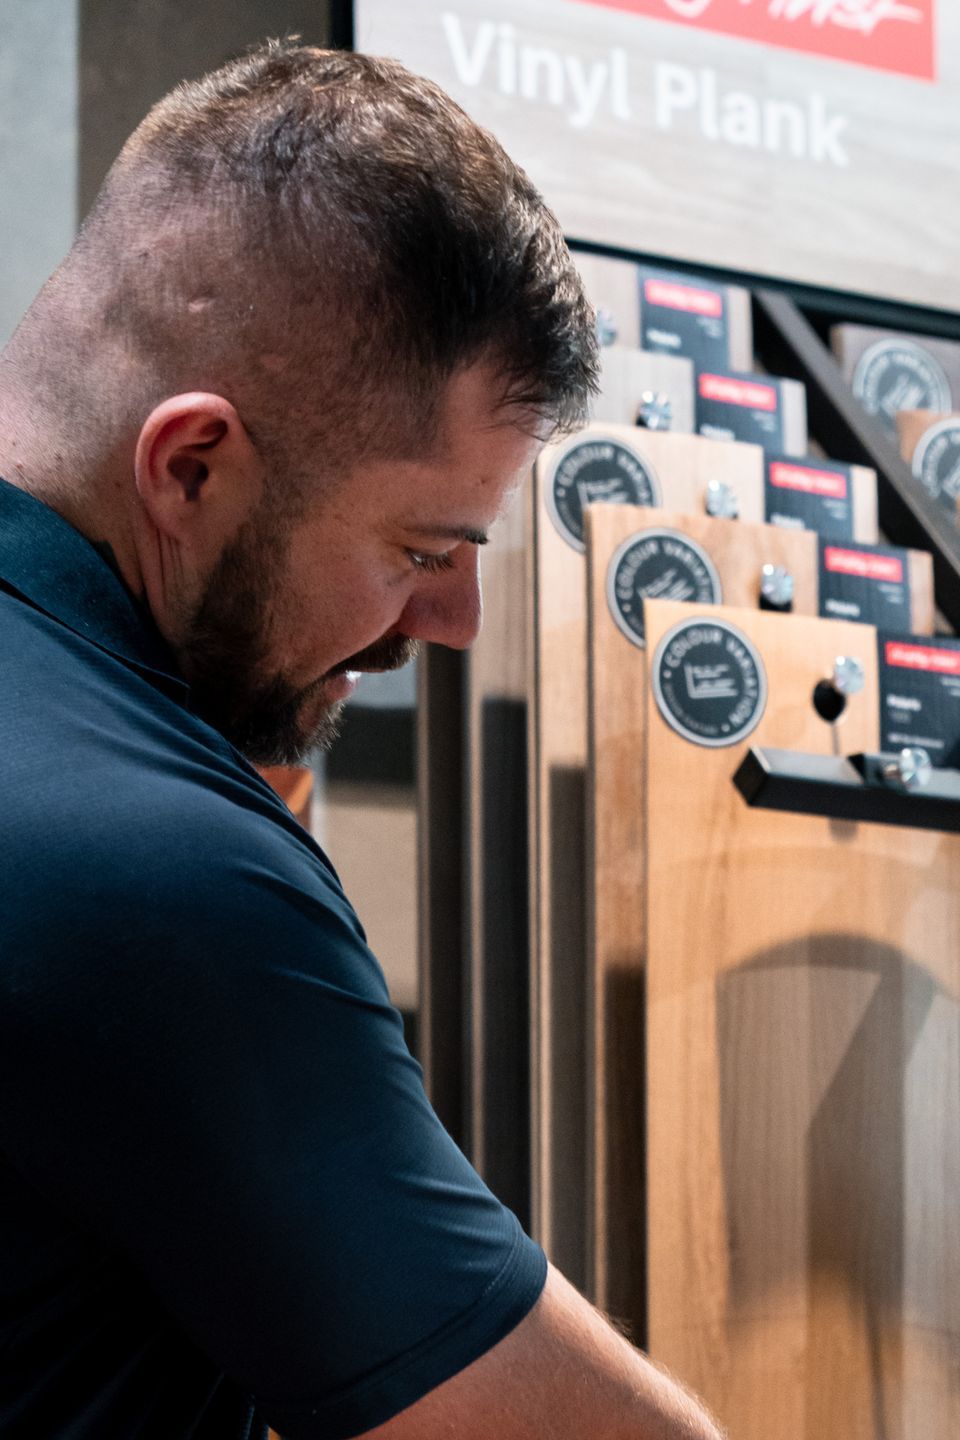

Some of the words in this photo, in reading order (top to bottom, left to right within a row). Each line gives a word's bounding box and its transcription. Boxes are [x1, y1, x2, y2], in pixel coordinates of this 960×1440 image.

[443, 13, 631, 129] Vinyl
[655, 62, 849, 166] Plank
[664, 627, 723, 668] COLOUR
[726, 636, 758, 726] VARIATION
